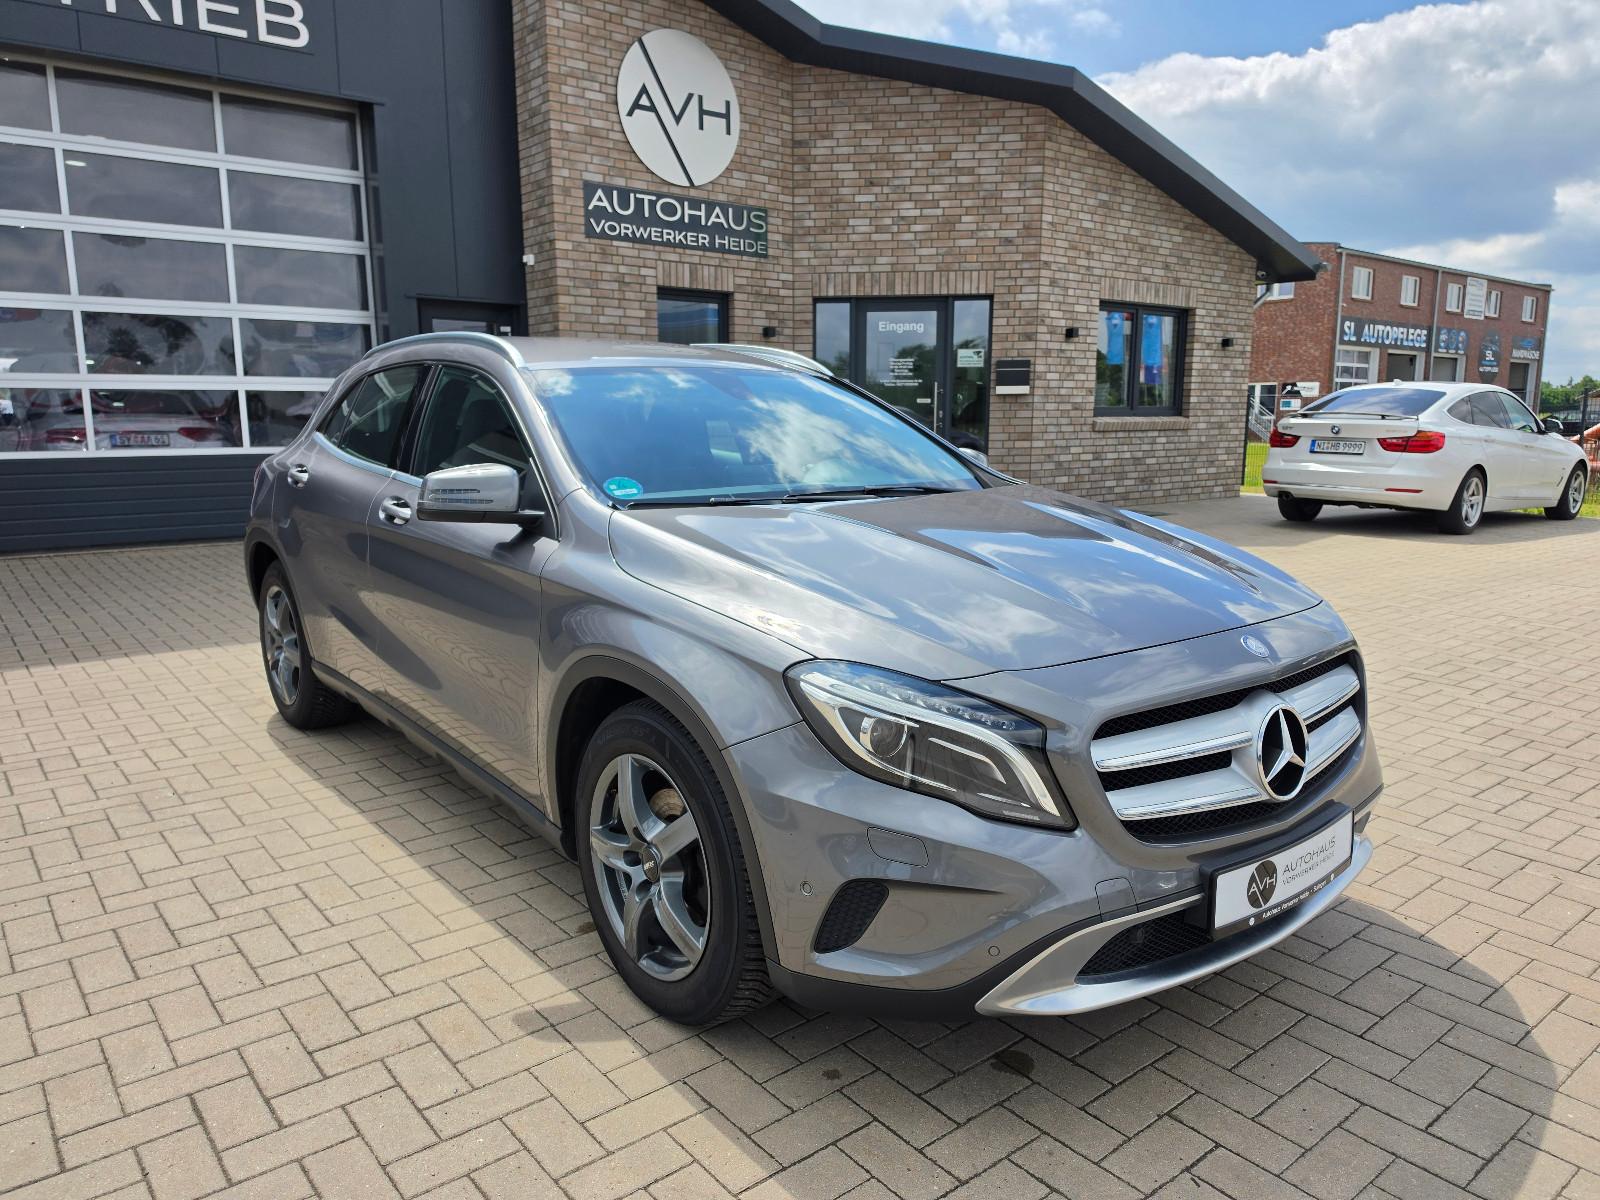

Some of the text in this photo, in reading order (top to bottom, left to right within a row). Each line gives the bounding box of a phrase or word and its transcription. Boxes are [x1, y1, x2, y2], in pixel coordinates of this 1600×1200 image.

[625, 82, 731, 136] AVH
[587, 187, 767, 233] AUTOHAUS
[589, 217, 767, 254] VORWERKER HEIDE
[878, 321, 924, 334] Eingang
[1343, 320, 1428, 348] SL AUTOPFLEGE
[1330, 442, 1341, 451] HB
[1342, 443, 1362, 452] 9999
[1282, 836, 1336, 876] AUTOHAUS
[1248, 873, 1276, 896] AVH
